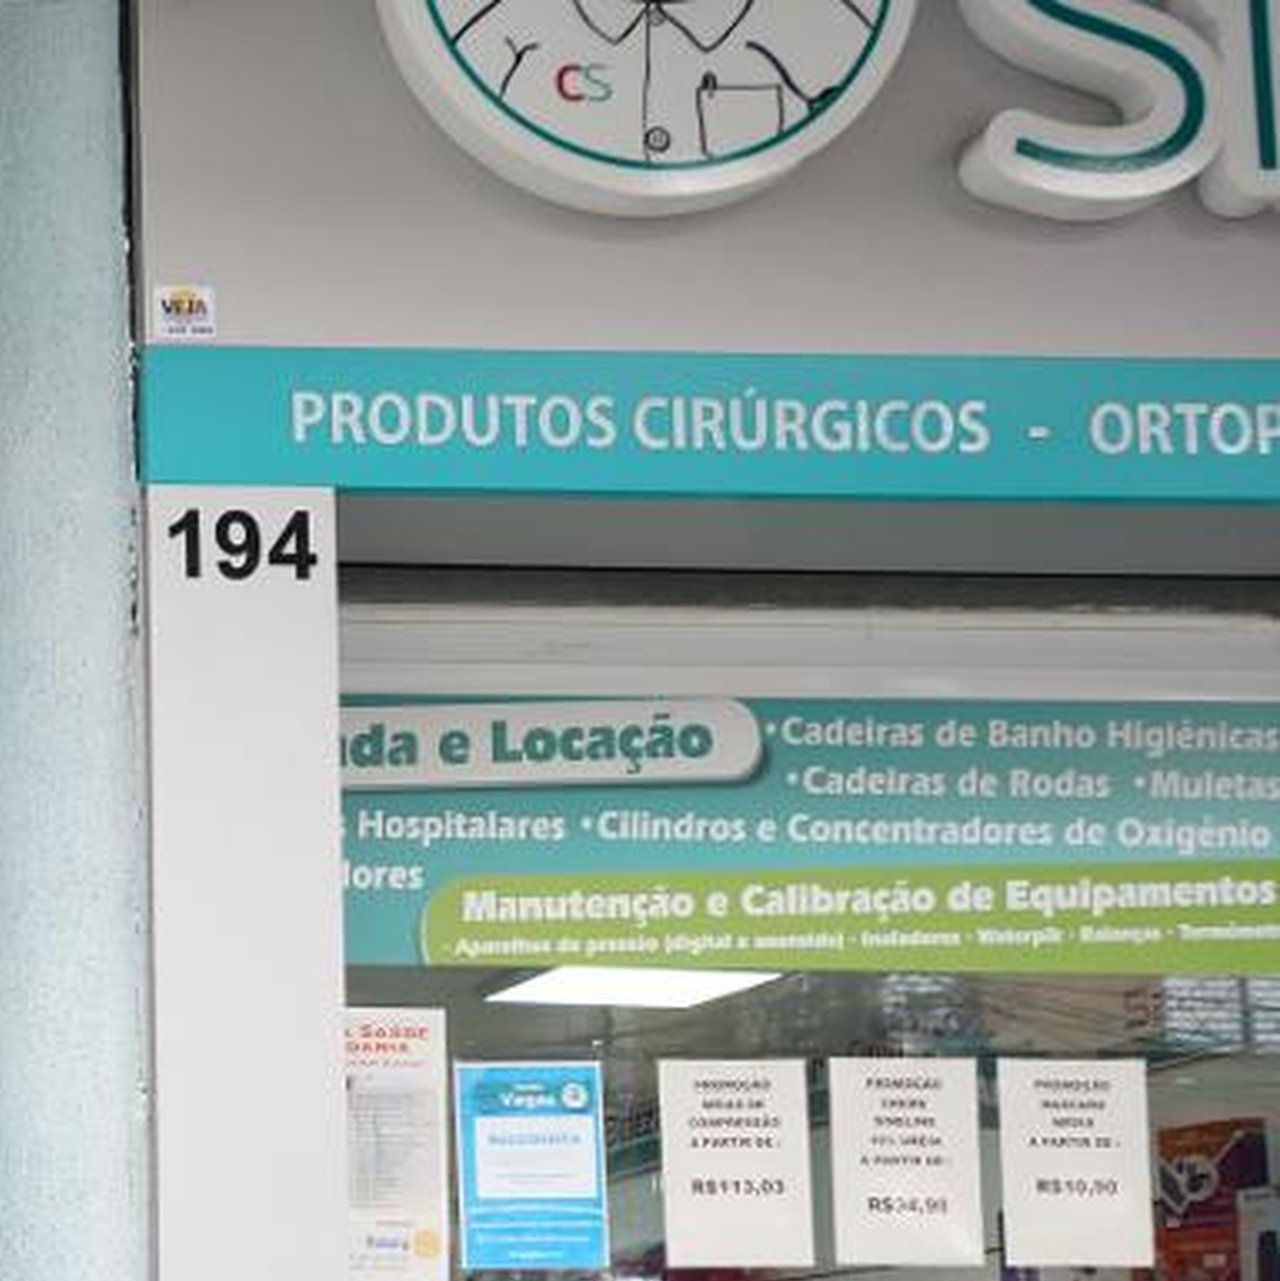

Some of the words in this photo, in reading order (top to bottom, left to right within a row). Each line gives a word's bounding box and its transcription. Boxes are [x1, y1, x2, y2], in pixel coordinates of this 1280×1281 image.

[290, 392, 617, 447] PRODUTOS
[633, 387, 991, 454] CIRÚRGICOS
[167, 507, 318, 581] 194
[340, 722, 418, 768] da
[439, 729, 471, 765] e
[491, 712, 714, 775] Locação
[781, 715, 923, 748] Cadeiras
[935, 718, 977, 748] de
[987, 719, 1097, 749] Banho
[1107, 720, 1279, 758] Higiênicas
[802, 765, 945, 797] Cadeiras
[957, 768, 999, 798] de
[1009, 768, 1112, 799] Rodas
[1150, 770, 1280, 801] Muletas
[357, 809, 566, 849] Hospitalares
[595, 810, 748, 842] Cilindros
[756, 816, 778, 842] e
[787, 812, 1053, 847] Concentradores
[1065, 816, 1105, 847] de
[1117, 815, 1272, 855] Oxigênio
[343, 860, 424, 889] ores
[461, 886, 695, 928] Manutenção
[706, 891, 729, 918] e
[740, 880, 937, 923] Calibração
[947, 881, 994, 913] de
[1005, 876, 1277, 917] Equipamentos
